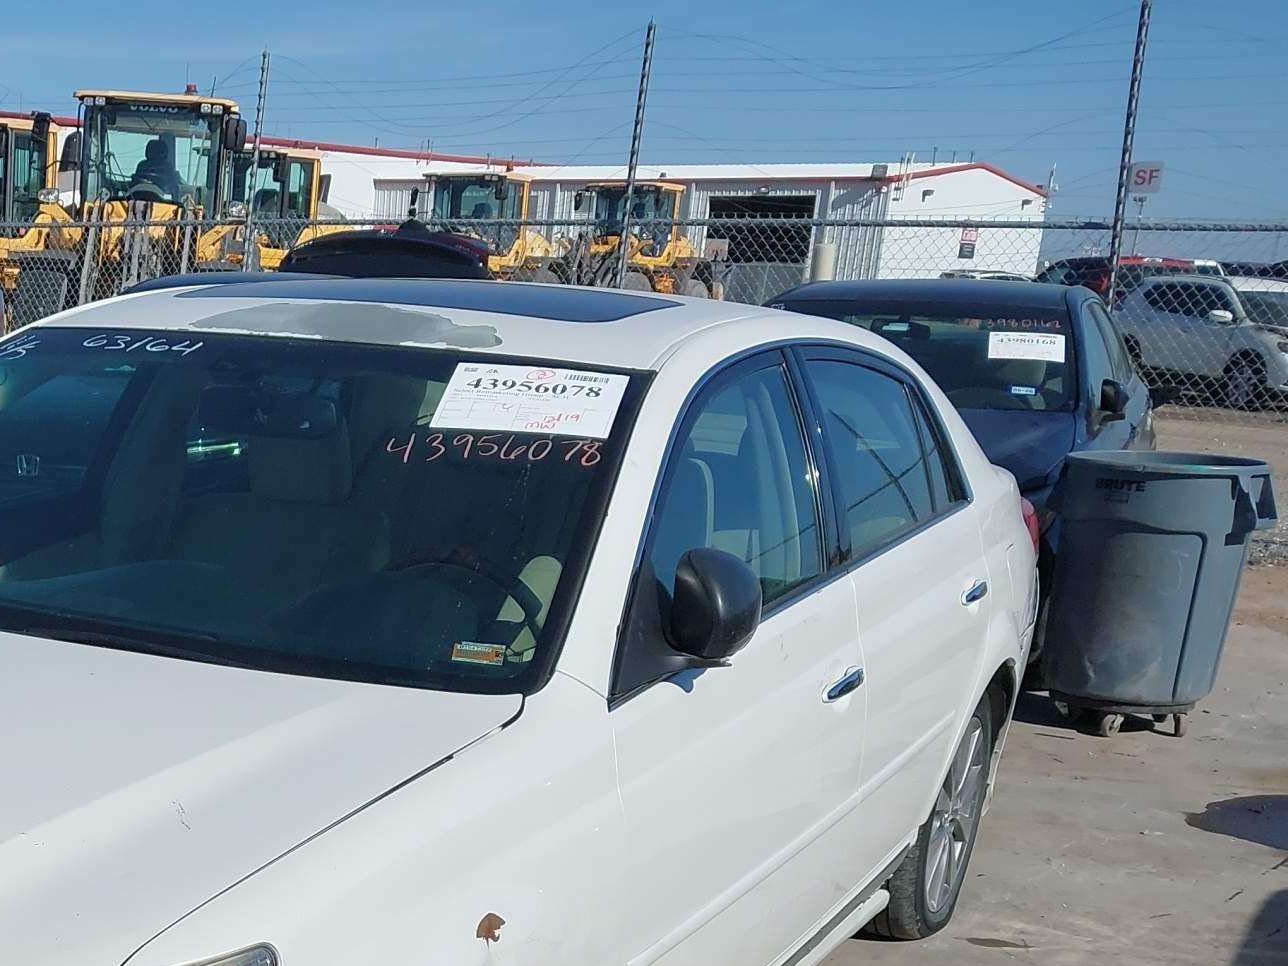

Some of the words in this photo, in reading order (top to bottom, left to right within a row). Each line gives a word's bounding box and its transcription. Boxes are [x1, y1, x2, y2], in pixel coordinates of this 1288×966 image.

[1133, 168, 1161, 185] SF
[466, 377, 603, 398] 43956078
[386, 433, 602, 466] 43956078
[1096, 478, 1147, 493] BRUTE
